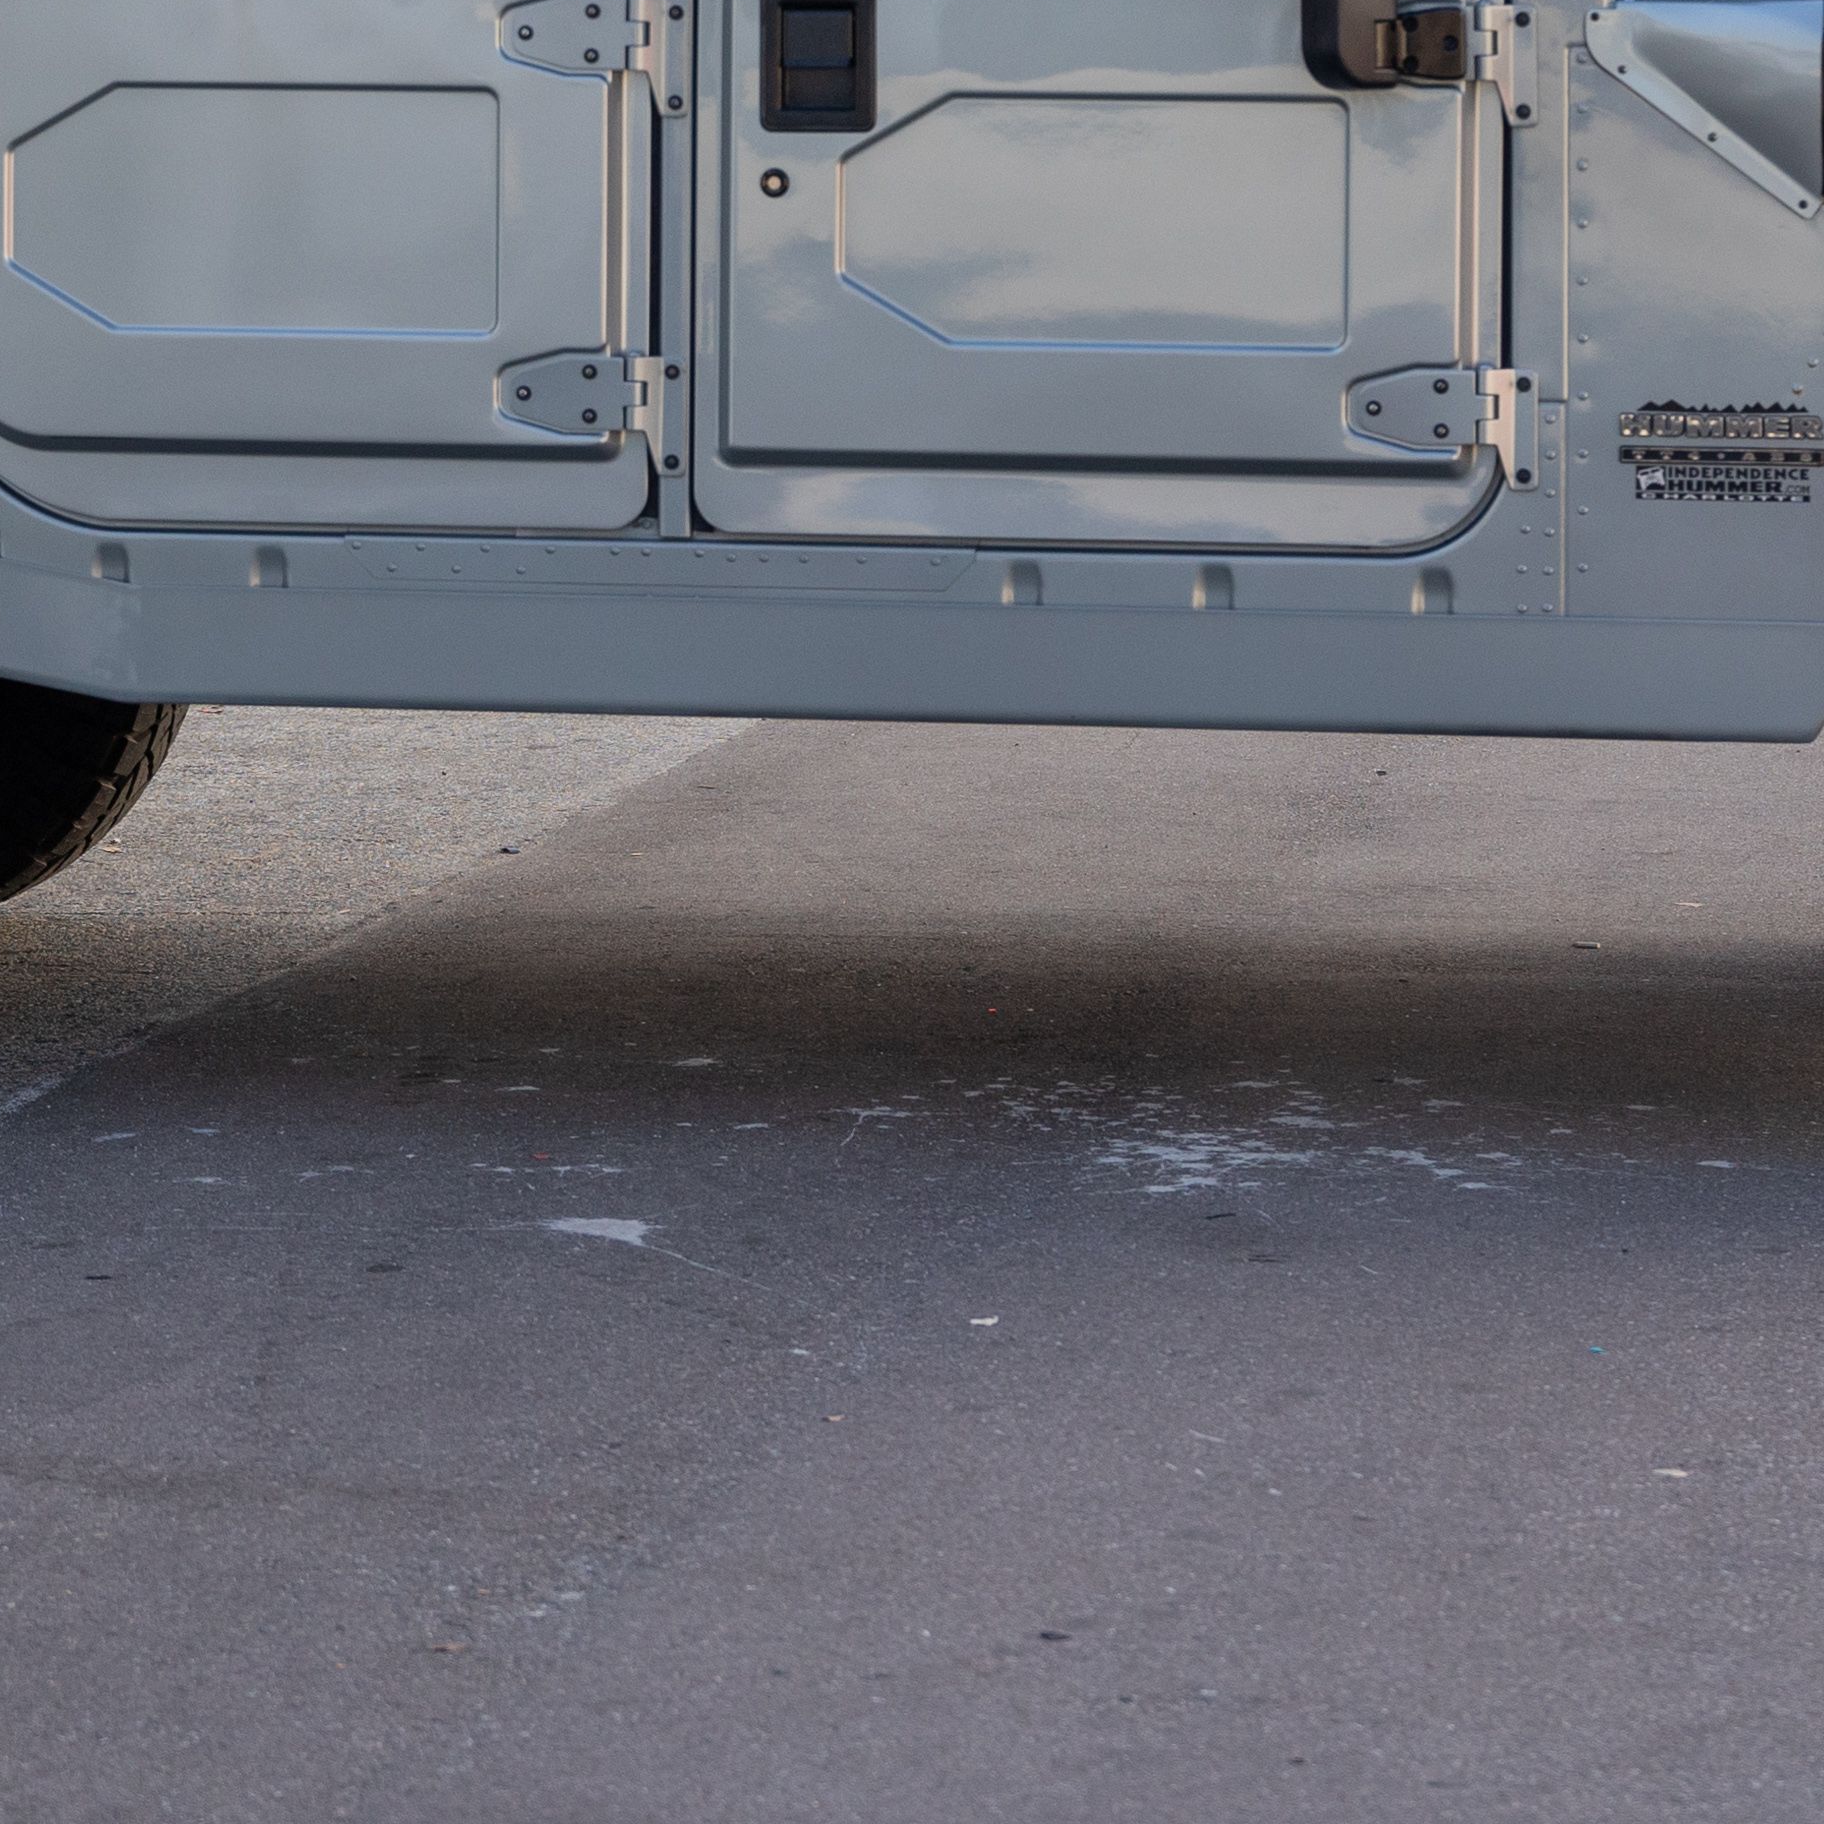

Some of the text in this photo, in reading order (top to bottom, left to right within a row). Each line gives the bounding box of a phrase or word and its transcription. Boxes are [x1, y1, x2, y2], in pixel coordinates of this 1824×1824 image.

[1619, 413, 1824, 440] HUMMER
[1668, 466, 1809, 480] INDEPENDENCE
[1641, 493, 1804, 502] CHARLOTTE
